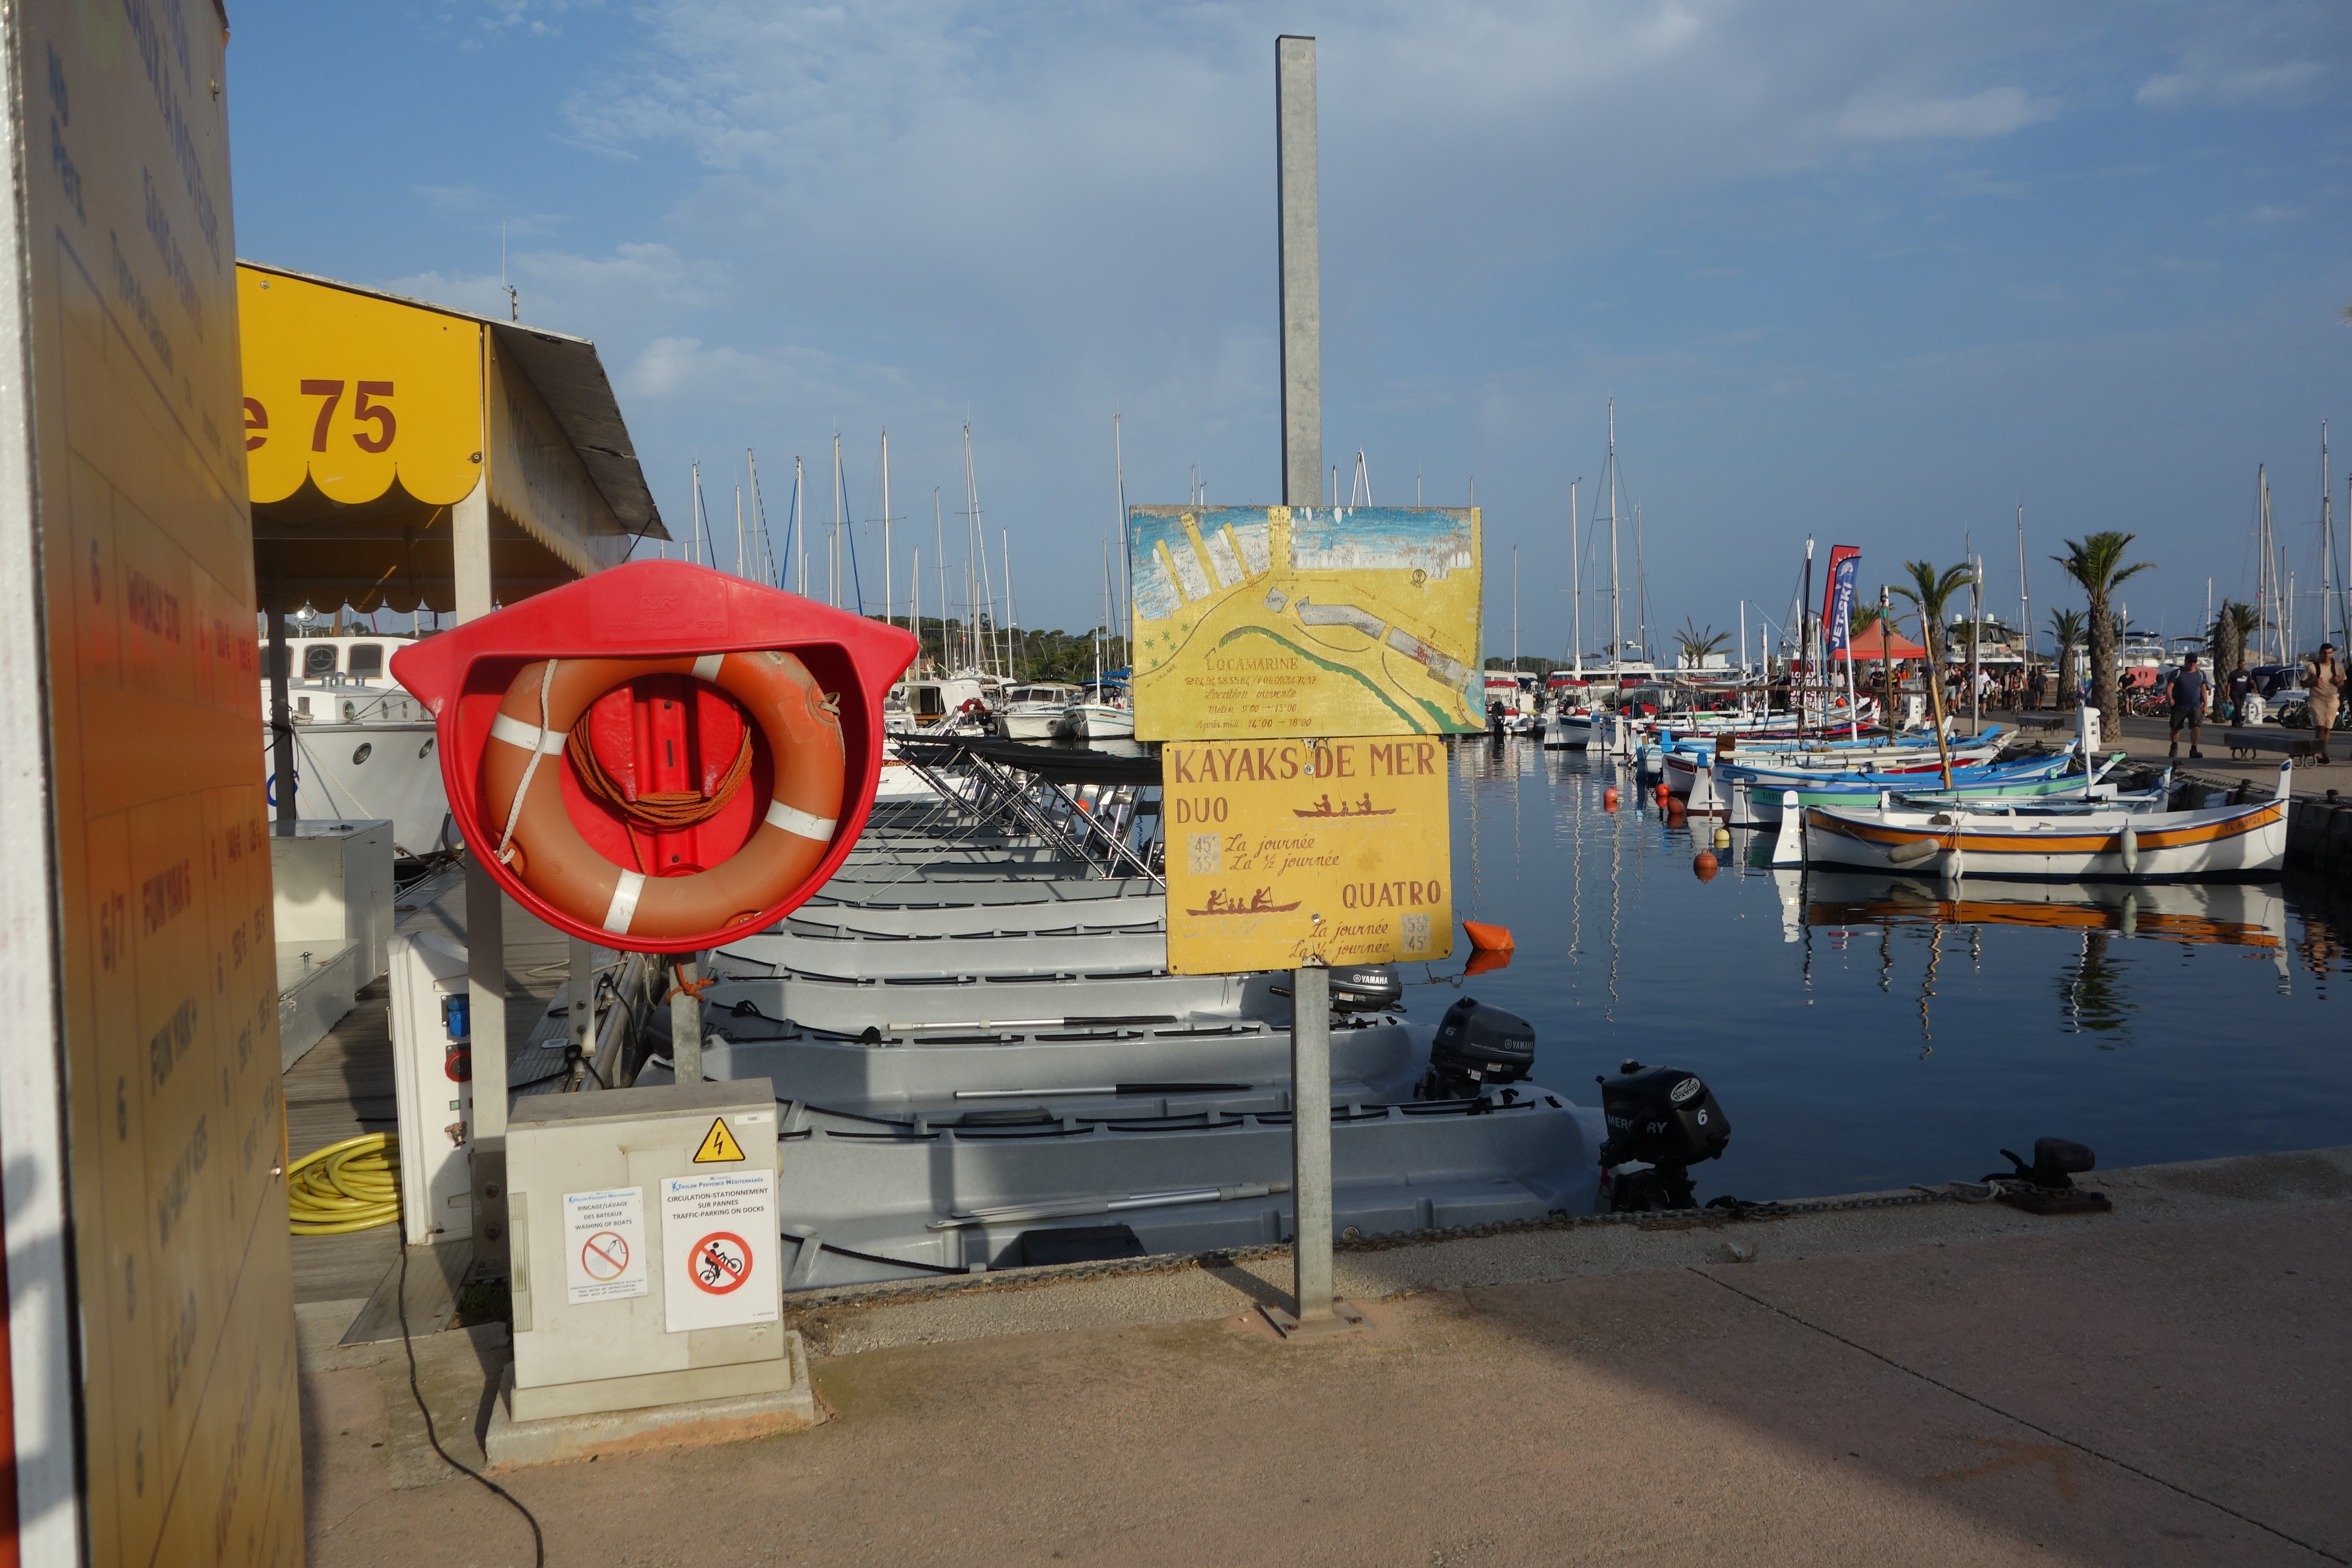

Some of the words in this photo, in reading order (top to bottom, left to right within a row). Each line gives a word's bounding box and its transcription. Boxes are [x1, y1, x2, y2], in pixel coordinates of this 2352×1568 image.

[301, 380, 396, 453] 75
[1207, 657, 1298, 671] LOCAMARINE
[1155, 663, 1176, 682] VILLAGE
[1256, 688, 1296, 698] ouverte
[1175, 747, 1298, 783] KAYAKS
[1315, 745, 1355, 778] DE
[1370, 742, 1436, 776] MER
[1176, 797, 1228, 824] DUO
[1225, 833, 1247, 852] La
[1254, 833, 1315, 858] journée
[1230, 854, 1253, 870] La
[1278, 850, 1340, 877] journée
[1343, 880, 1441, 909] QUATRO
[1309, 919, 1327, 938] La
[1330, 919, 1389, 944] journée
[1289, 939, 1308, 958] La
[1332, 938, 1390, 963] journée
[1362, 975, 1388, 985] YAMAHA
[1445, 1026, 1456, 1037] 6
[1513, 1040, 1534, 1050] YAMAHA
[1697, 1109, 1708, 1126] 6
[667, 1188, 768, 1203] CIRCULATION-STATIONNEMENT
[713, 1199, 739, 1207] PANNES
[577, 1200, 628, 1211] RINCAGE/LAVAGE
[672, 1209, 730, 1220] TRAFFIC-PARKING
[575, 1222, 603, 1231] WASHING
